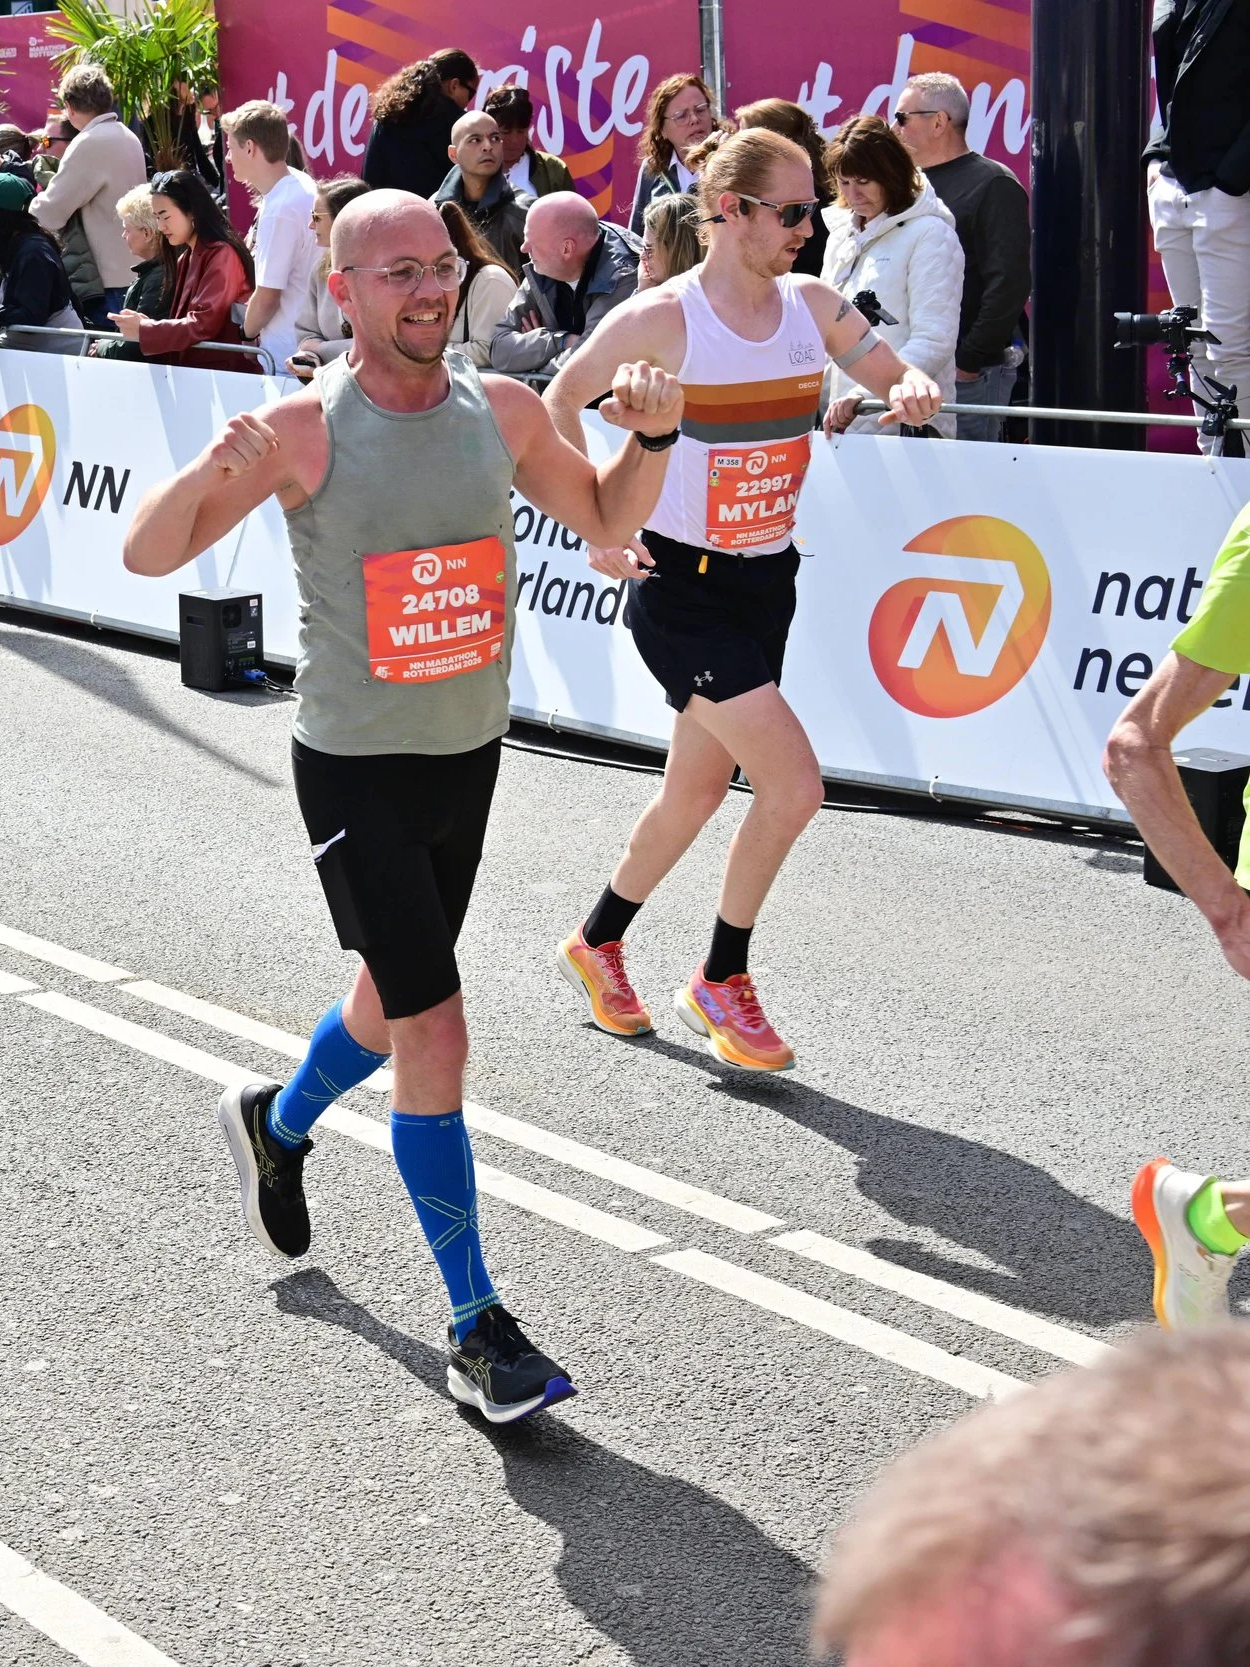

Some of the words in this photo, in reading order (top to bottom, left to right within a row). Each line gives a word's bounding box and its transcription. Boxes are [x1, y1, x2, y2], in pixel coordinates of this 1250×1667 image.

[771, 453, 787, 464] NN
[62, 460, 131, 514] NN
[735, 472, 793, 497] 22997
[718, 489, 799, 522] MYLAN
[446, 557, 467, 571] NN
[401, 583, 480, 615] 24708
[388, 609, 492, 647] WILLEM
[402, 663, 462, 679] ROTTERDAM
[409, 660, 426, 670] NN
[426, 650, 478, 668] MARATHON
